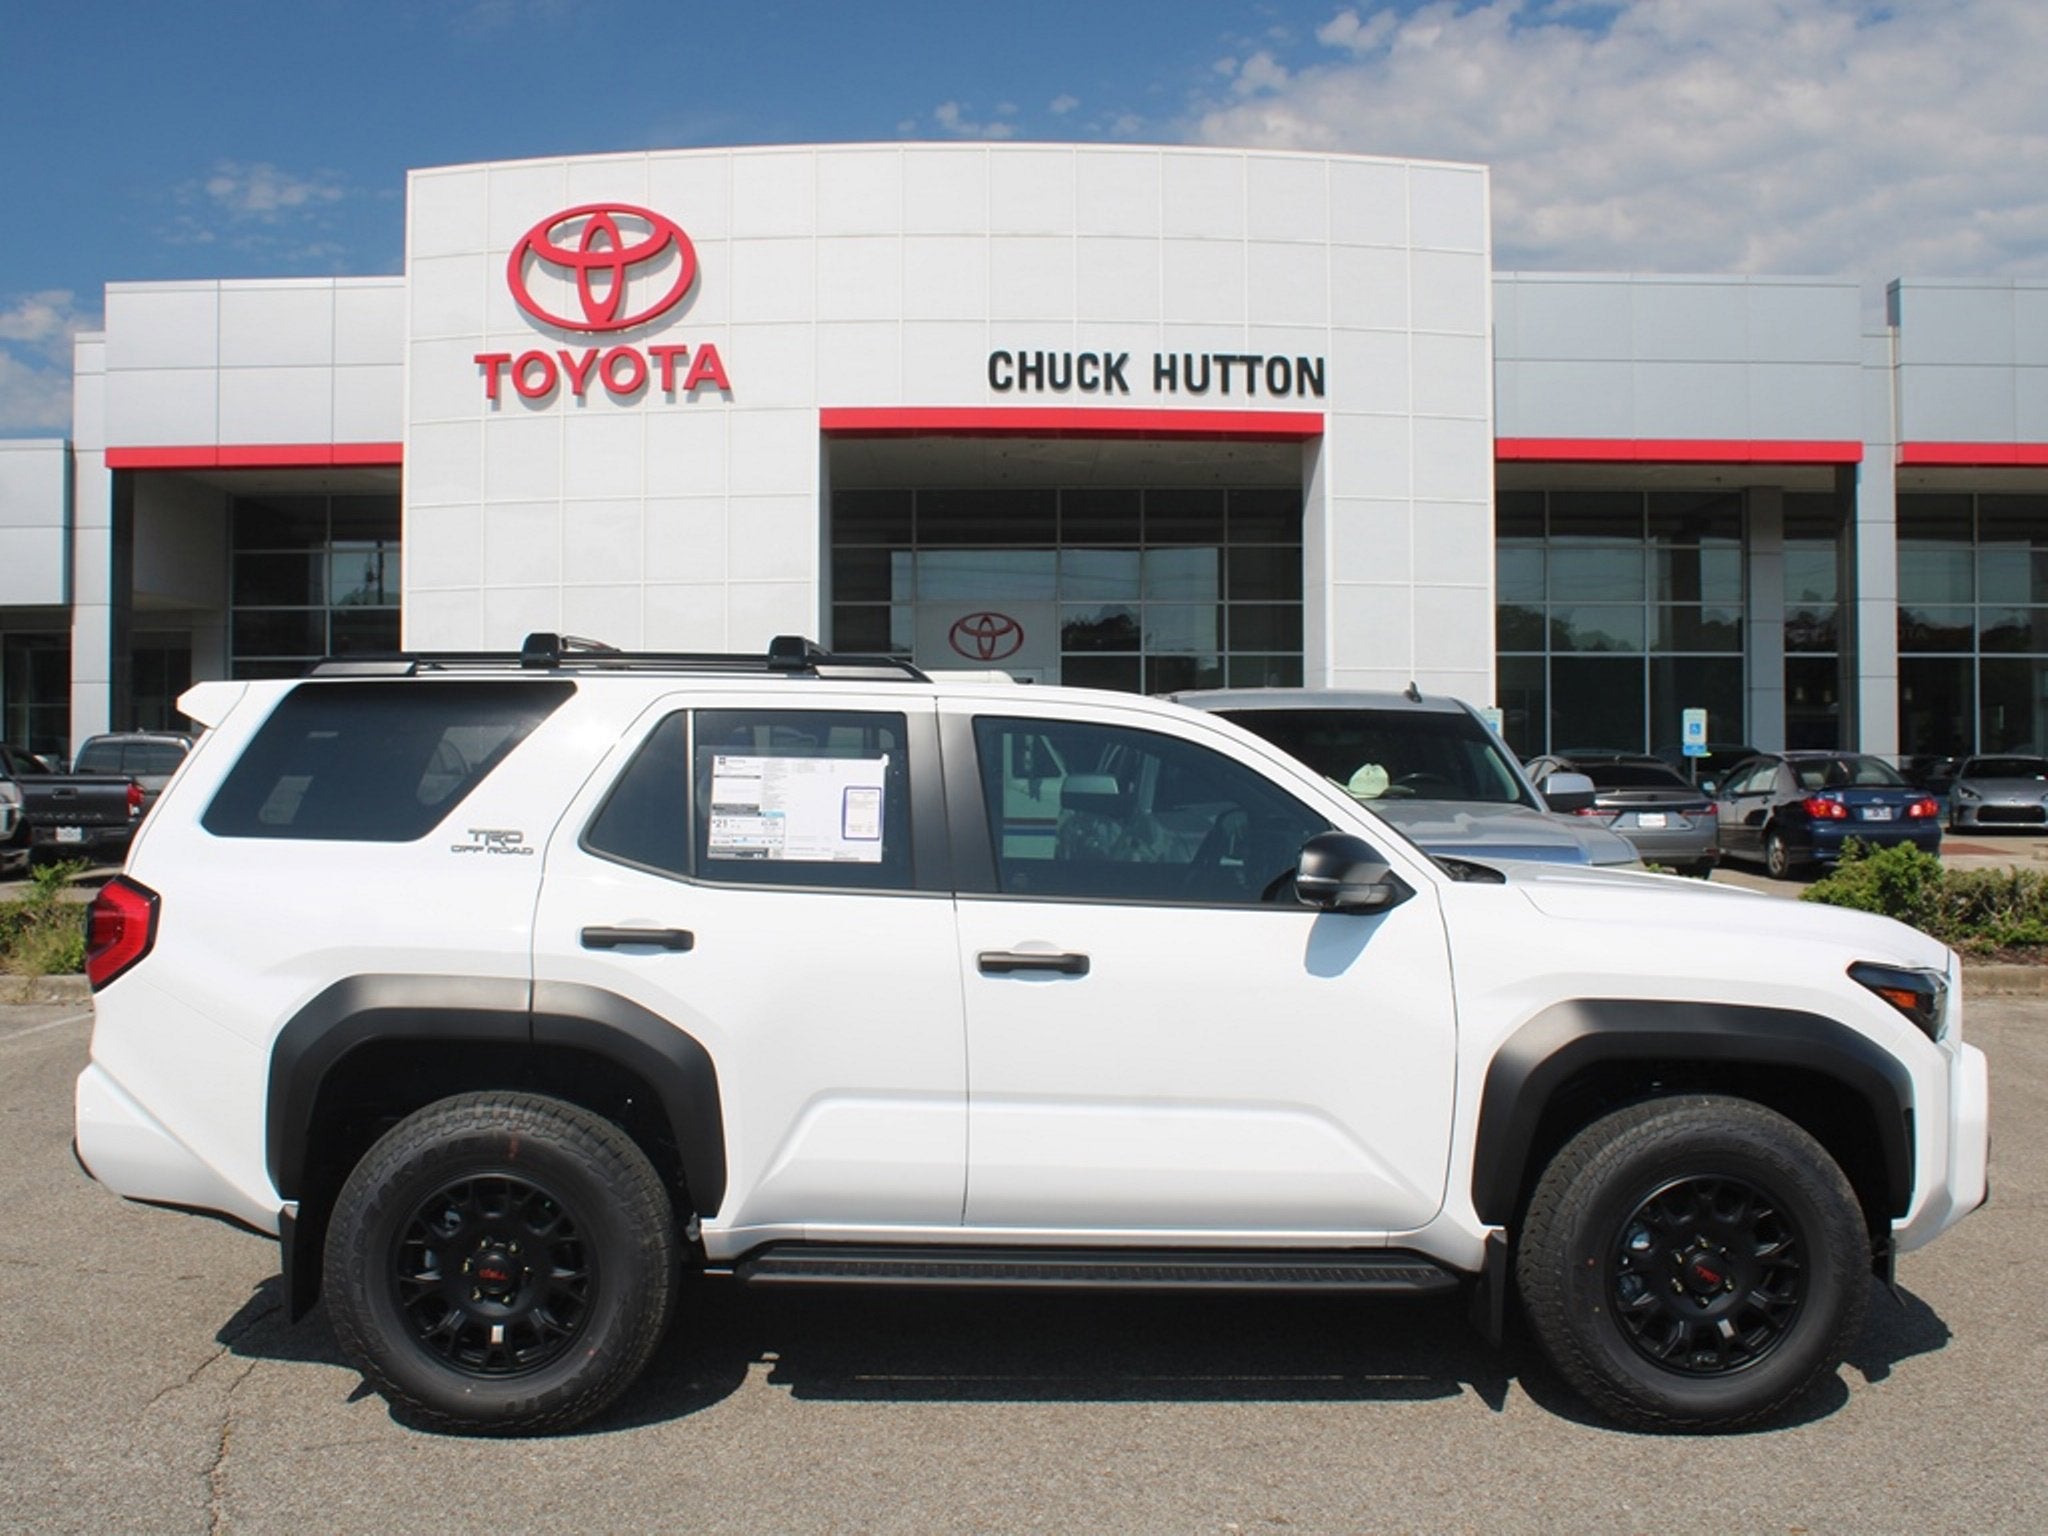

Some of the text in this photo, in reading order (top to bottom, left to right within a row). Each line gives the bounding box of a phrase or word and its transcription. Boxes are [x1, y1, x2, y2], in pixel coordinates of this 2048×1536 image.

[474, 343, 732, 401] TOYOTA
[988, 351, 1325, 397] CHUCK HUTTON
[450, 844, 534, 856] OFF ROAD
[467, 829, 524, 846] TRD
